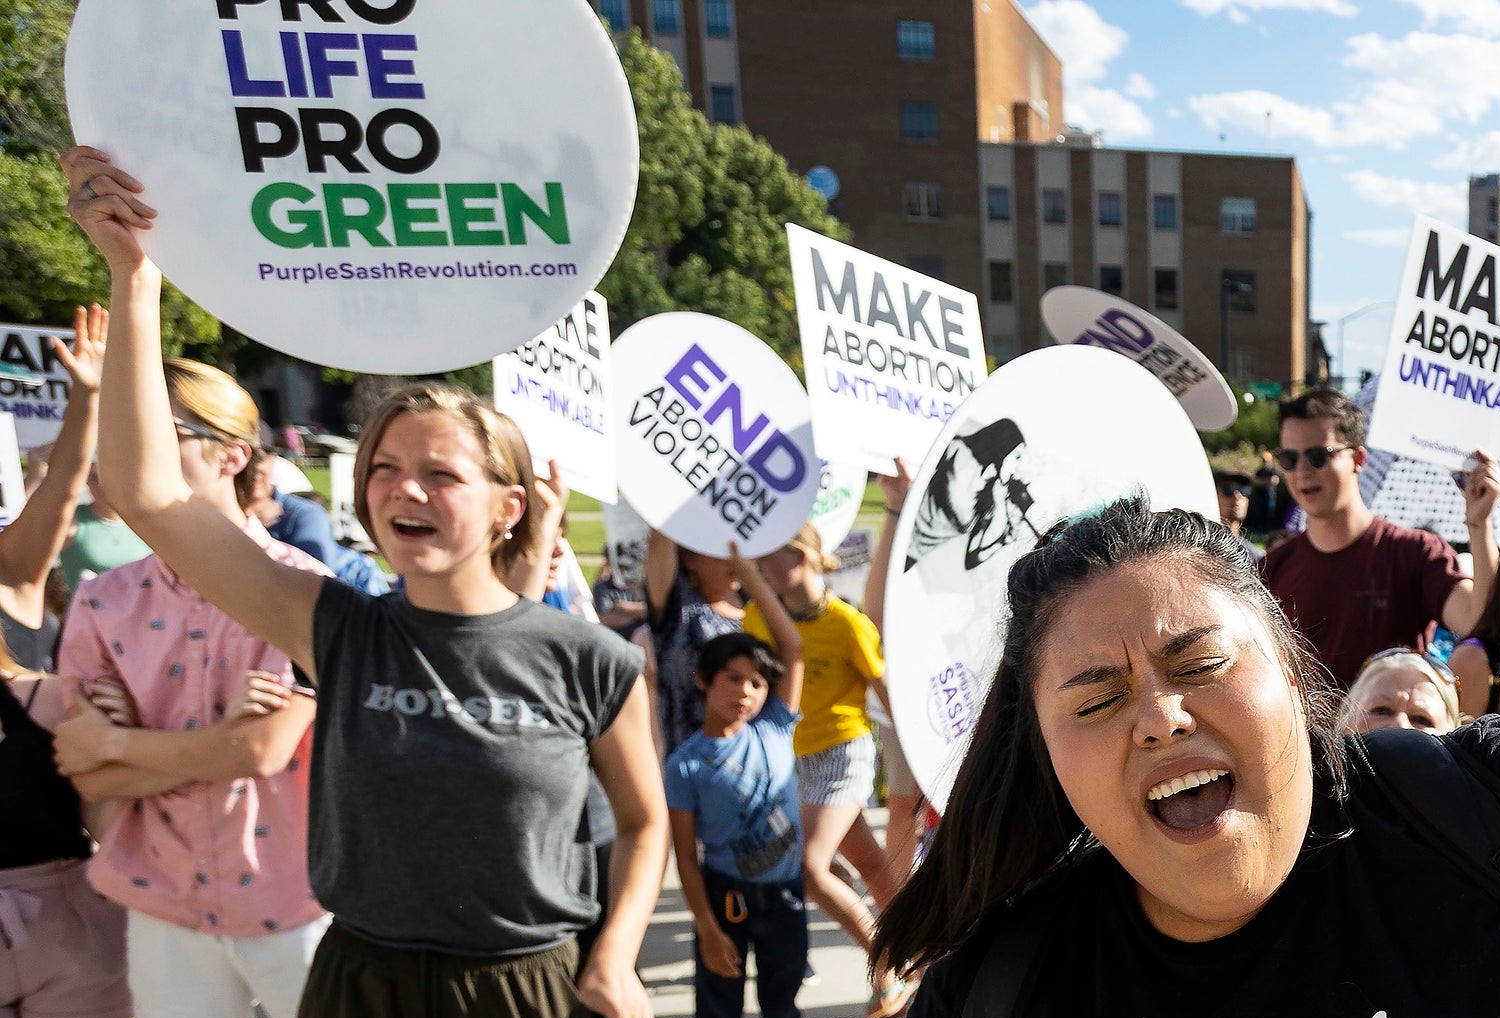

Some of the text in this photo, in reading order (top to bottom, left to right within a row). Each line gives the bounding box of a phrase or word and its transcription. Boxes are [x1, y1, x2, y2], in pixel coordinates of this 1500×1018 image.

[221, 29, 426, 99] LIFE
[234, 106, 441, 174] PRO
[251, 181, 572, 249] GREEN
[258, 261, 578, 284] PurpleSashRevolution.com
[810, 246, 970, 360] MAKE
[823, 324, 977, 397] ABORTION
[643, 386, 777, 517] ABORTION
[664, 343, 806, 493] END
[629, 401, 761, 540] VIOLENCE
[939, 667, 969, 739] SASH
